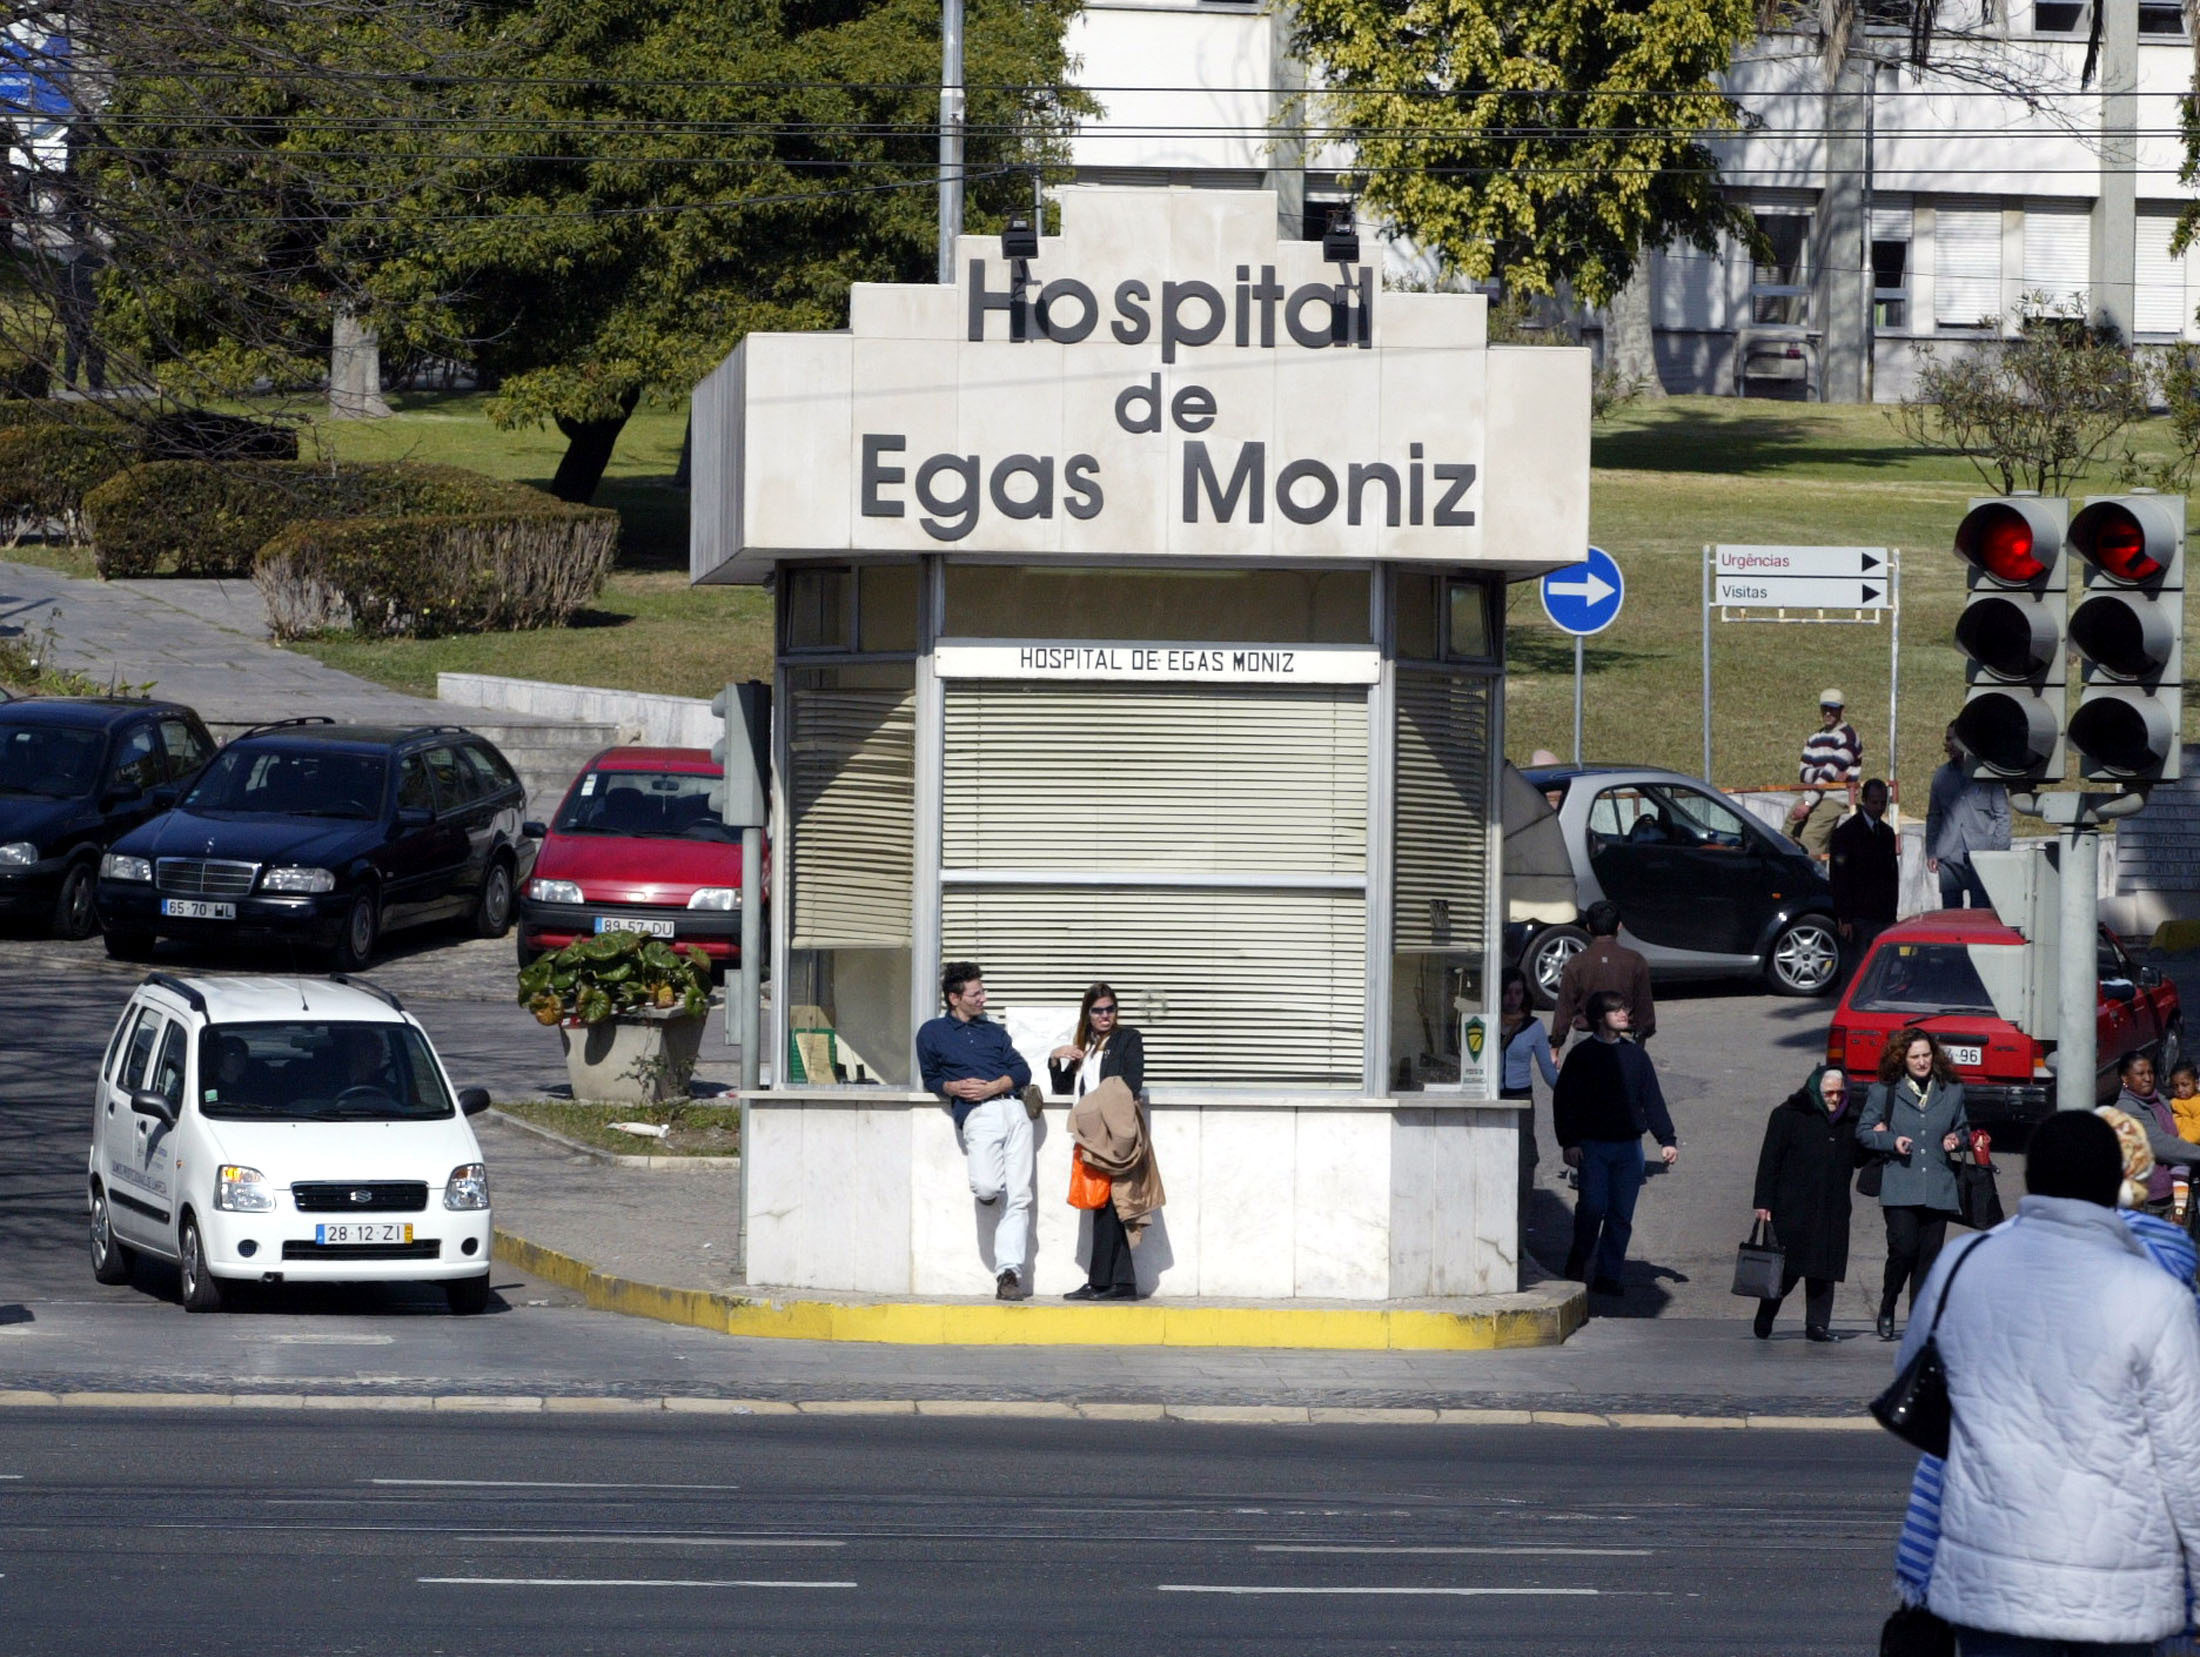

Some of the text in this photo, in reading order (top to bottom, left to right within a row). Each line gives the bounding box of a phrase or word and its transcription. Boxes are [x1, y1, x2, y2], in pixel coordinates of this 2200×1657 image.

[968, 259, 1373, 364] Hospital
[1115, 372, 1217, 434] de
[861, 433, 1476, 542] Egas Moniz
[1721, 553, 1790, 569] Urgências
[1722, 585, 1768, 599] Visitas
[1020, 647, 1294, 672] HOSPITAL DE EGAS MONIZ
